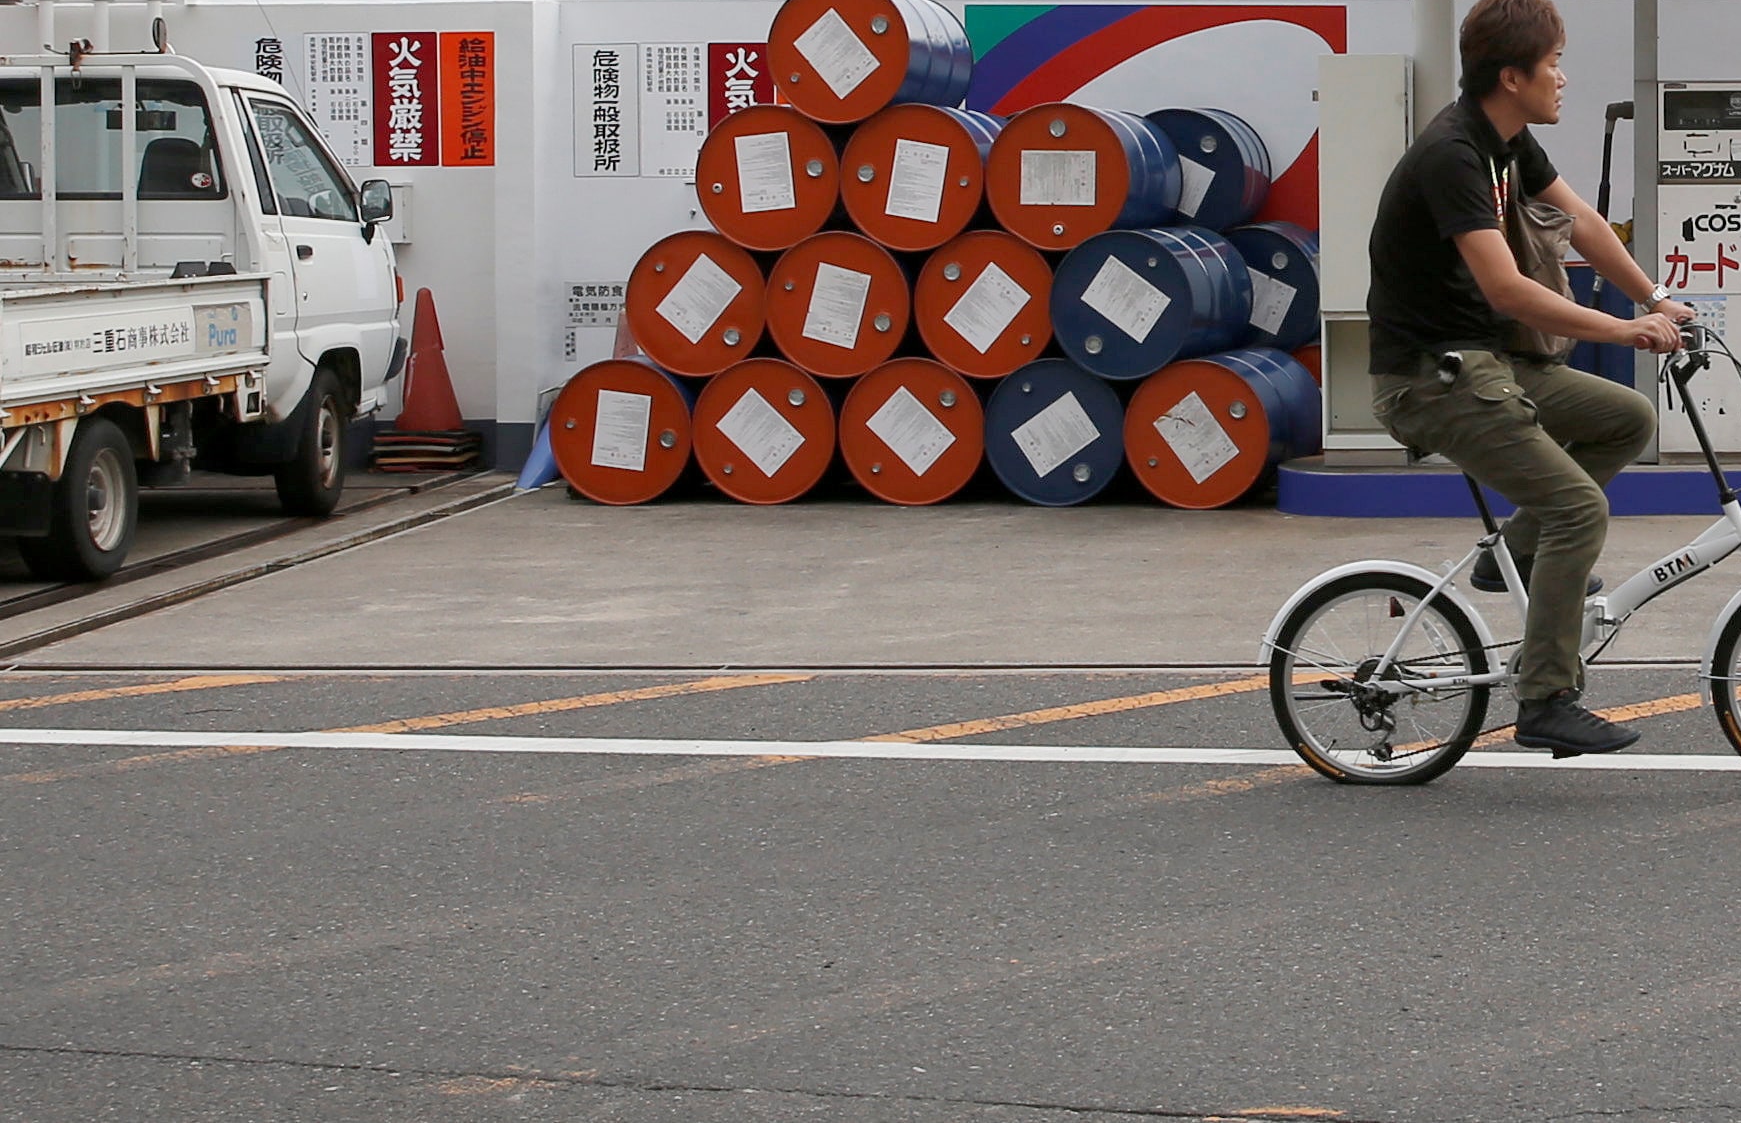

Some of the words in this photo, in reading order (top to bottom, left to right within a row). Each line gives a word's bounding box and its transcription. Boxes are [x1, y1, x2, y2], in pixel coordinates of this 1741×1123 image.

[388, 36, 422, 162] 火気厳禁
[458, 37, 488, 161] 給油中エンジン停止
[592, 49, 621, 172] 危険物一般取扱所
[1662, 163, 1735, 177] スーパーマグナム
[93, 322, 190, 353] 三重石商事株式会社
[208, 324, 238, 347] Pura
[1654, 553, 1694, 582] BTM
